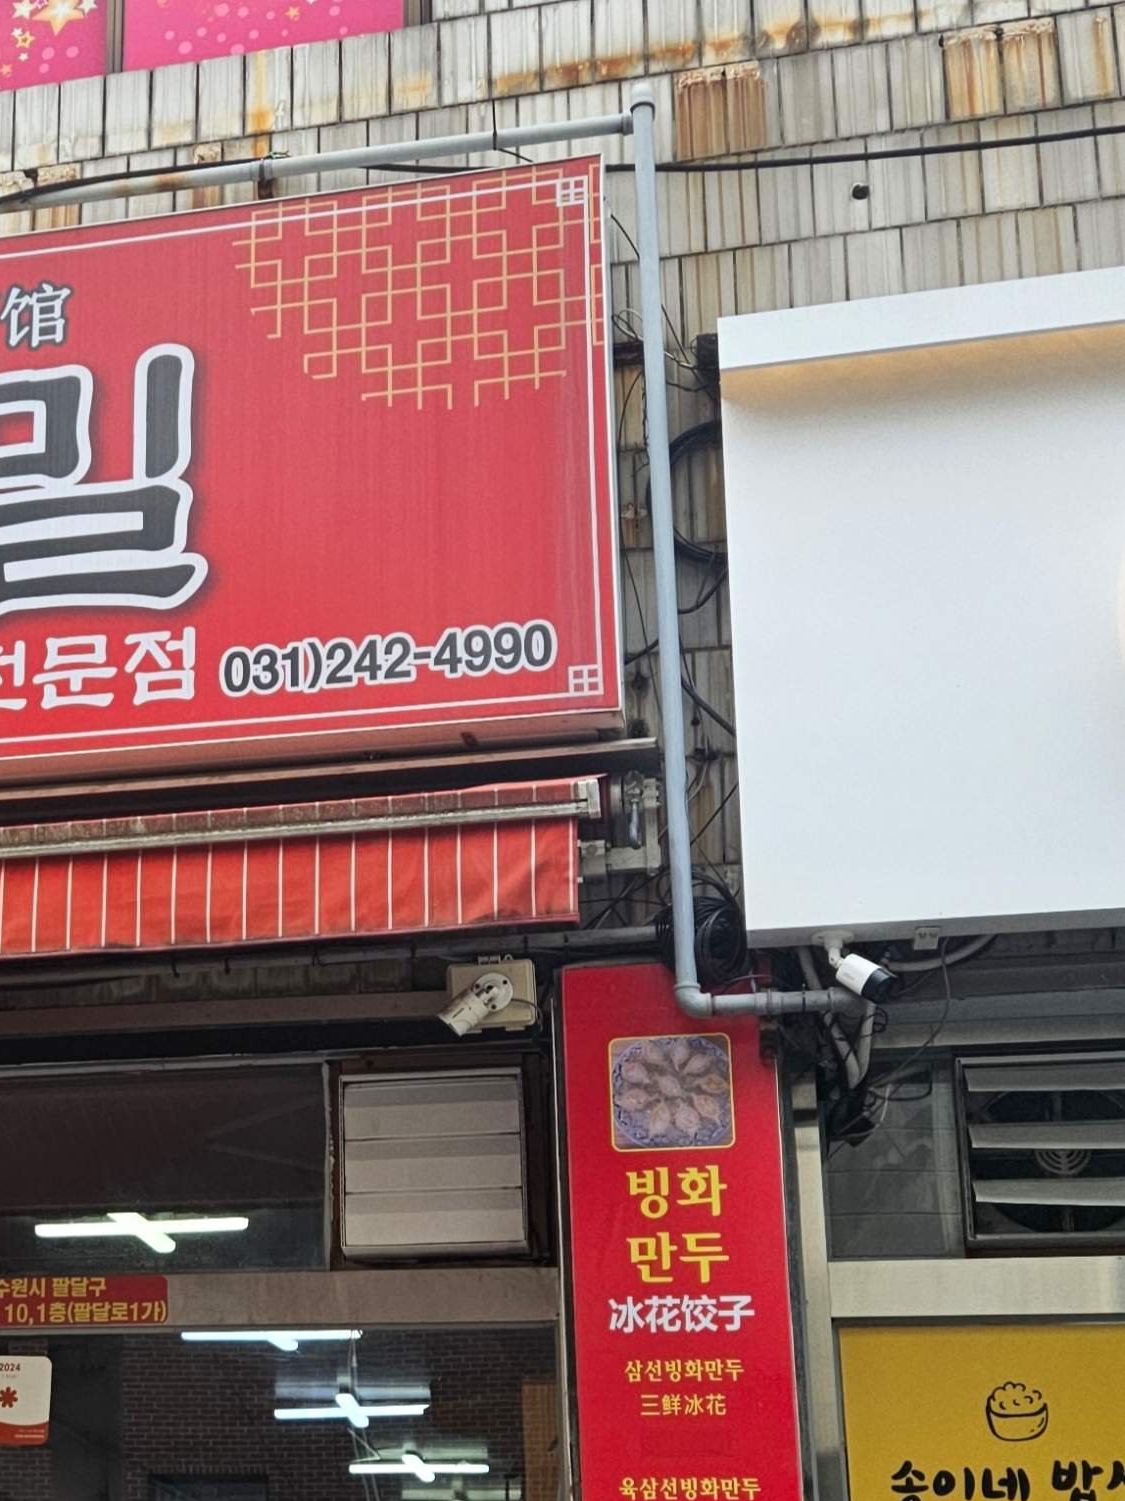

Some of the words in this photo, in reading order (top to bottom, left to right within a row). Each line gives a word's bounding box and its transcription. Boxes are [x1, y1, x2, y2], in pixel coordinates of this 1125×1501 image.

[220, 618, 557, 697] 031)242-4990
[625, 1165, 727, 1219] 빙화
[626, 1232, 729, 1283] 만두
[52, 1276, 107, 1298] 팔달구
[609, 1294, 755, 1333] 冰花饺子
[624, 1359, 745, 1383] 삼선빙화만두
[640, 1393, 727, 1416] 三鲜冰花
[619, 1477, 761, 1501] 육삼선빙화만두
